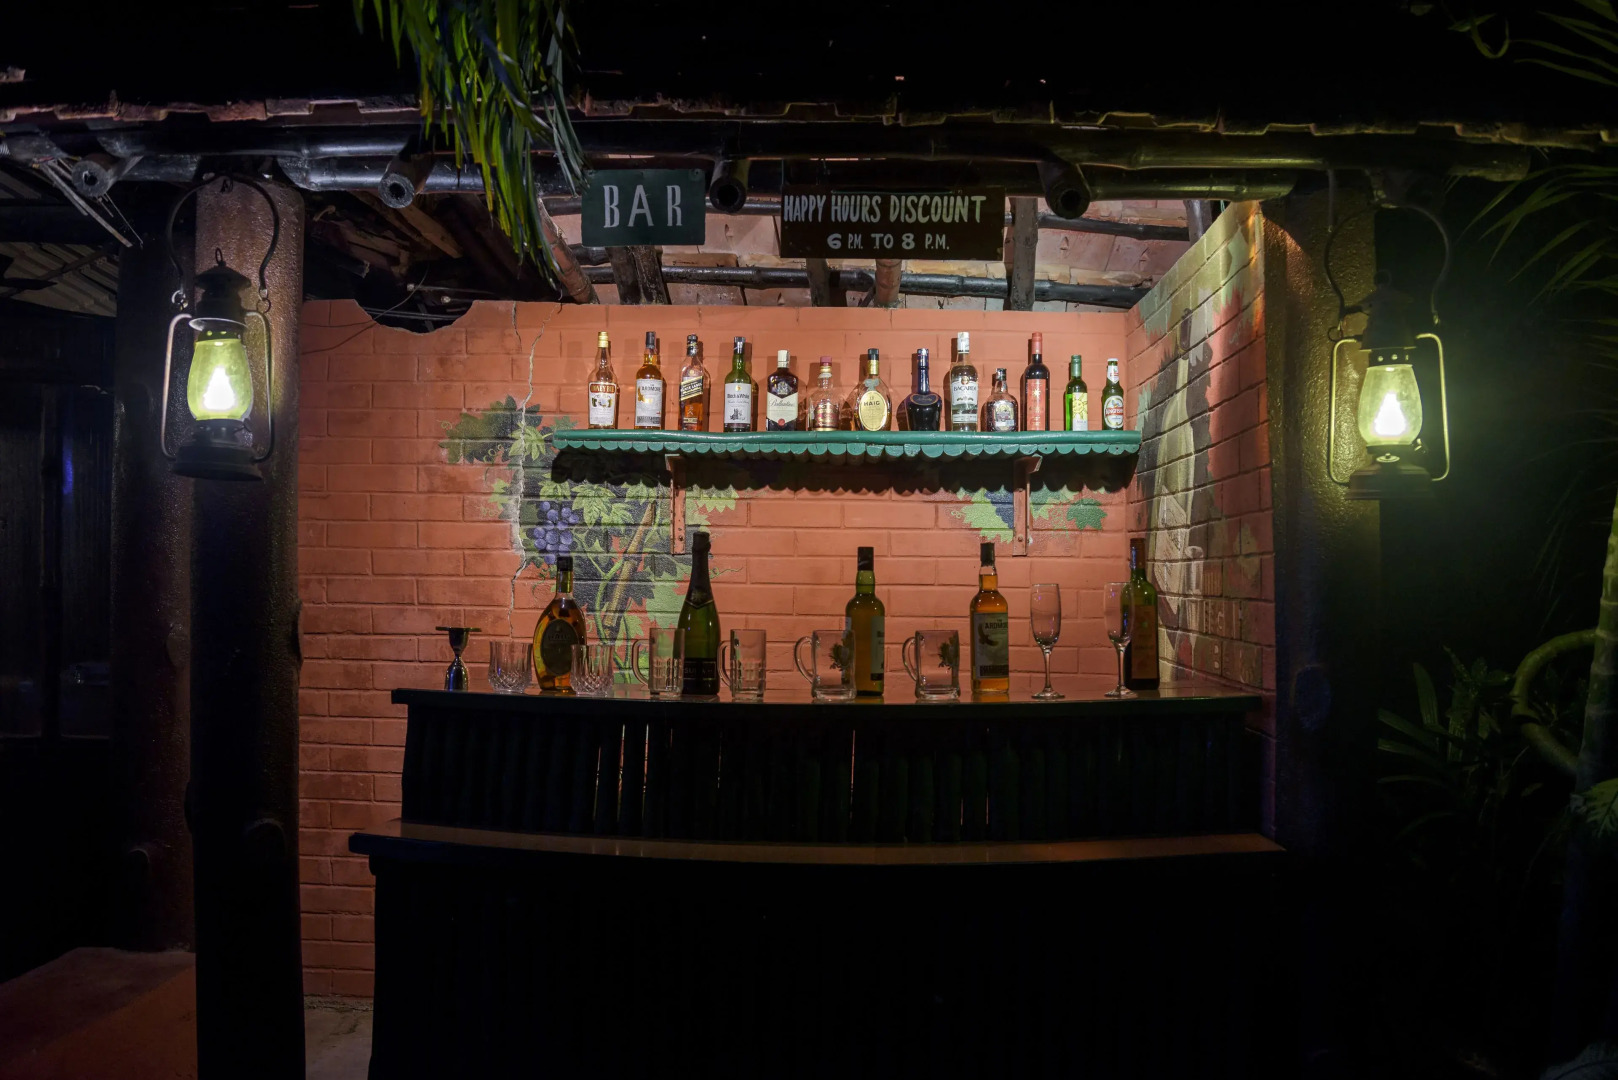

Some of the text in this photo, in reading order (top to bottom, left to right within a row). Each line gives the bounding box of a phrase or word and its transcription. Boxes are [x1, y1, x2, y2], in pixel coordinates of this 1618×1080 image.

[603, 184, 683, 229] BAR
[784, 194, 987, 224] HAPPY HOURS DISCOUNT
[826, 234, 843, 249] 6
[871, 234, 894, 249] TO
[901, 234, 916, 250] 8
[924, 234, 950, 250] P.M.
